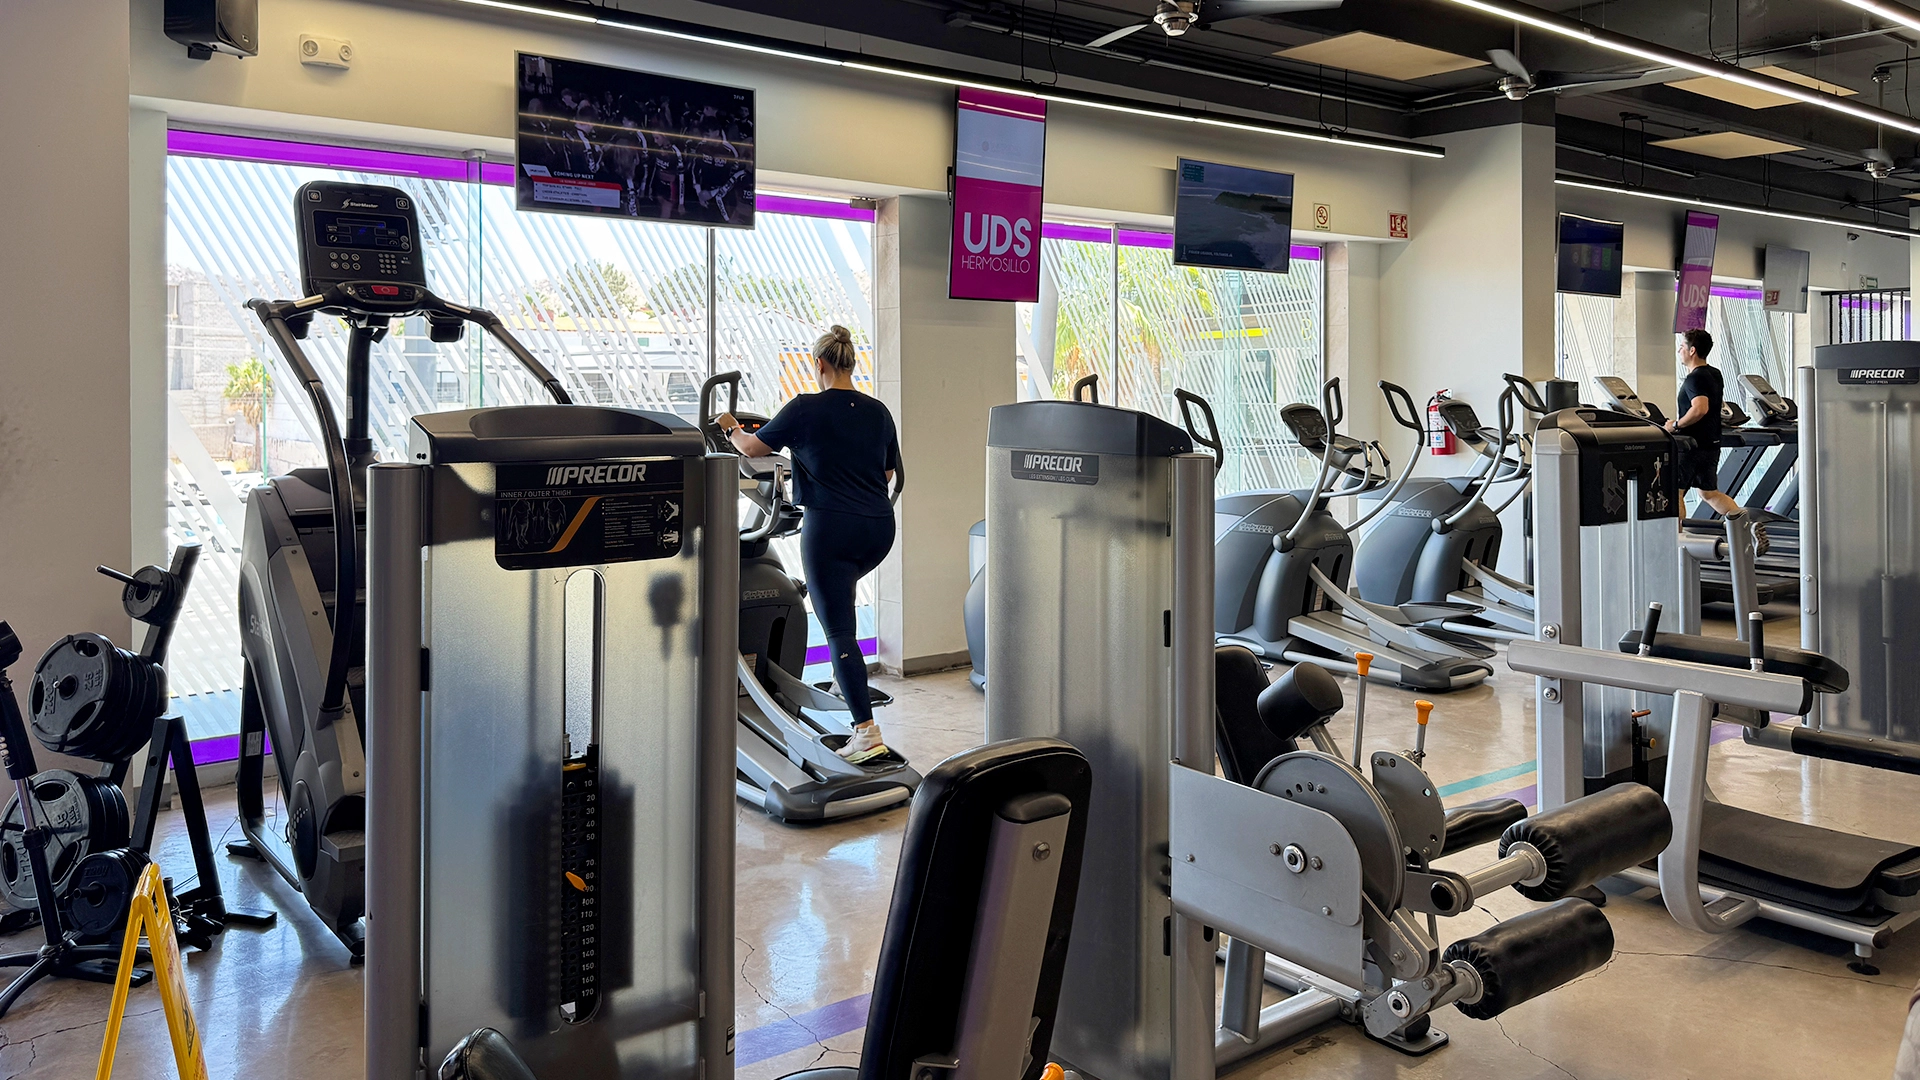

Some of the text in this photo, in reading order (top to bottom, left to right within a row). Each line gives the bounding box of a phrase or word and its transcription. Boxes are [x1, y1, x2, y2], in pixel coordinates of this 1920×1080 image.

[553, 170, 574, 178] COMING
[963, 211, 1032, 258] UDS
[961, 254, 1031, 274] HERMOSILLO
[1682, 284, 1707, 308] UDS
[1858, 369, 1905, 378] PRECOR
[1032, 454, 1082, 472] PRECOR
[562, 464, 647, 485] PRECOR
[528, 490, 550, 498] OUTER
[84, 671, 94, 691] 25
[582, 898, 594, 906] 100
[582, 924, 594, 932] 120
[582, 937, 594, 945] 130
[582, 962, 594, 970] 150
[582, 988, 593, 996] 170
